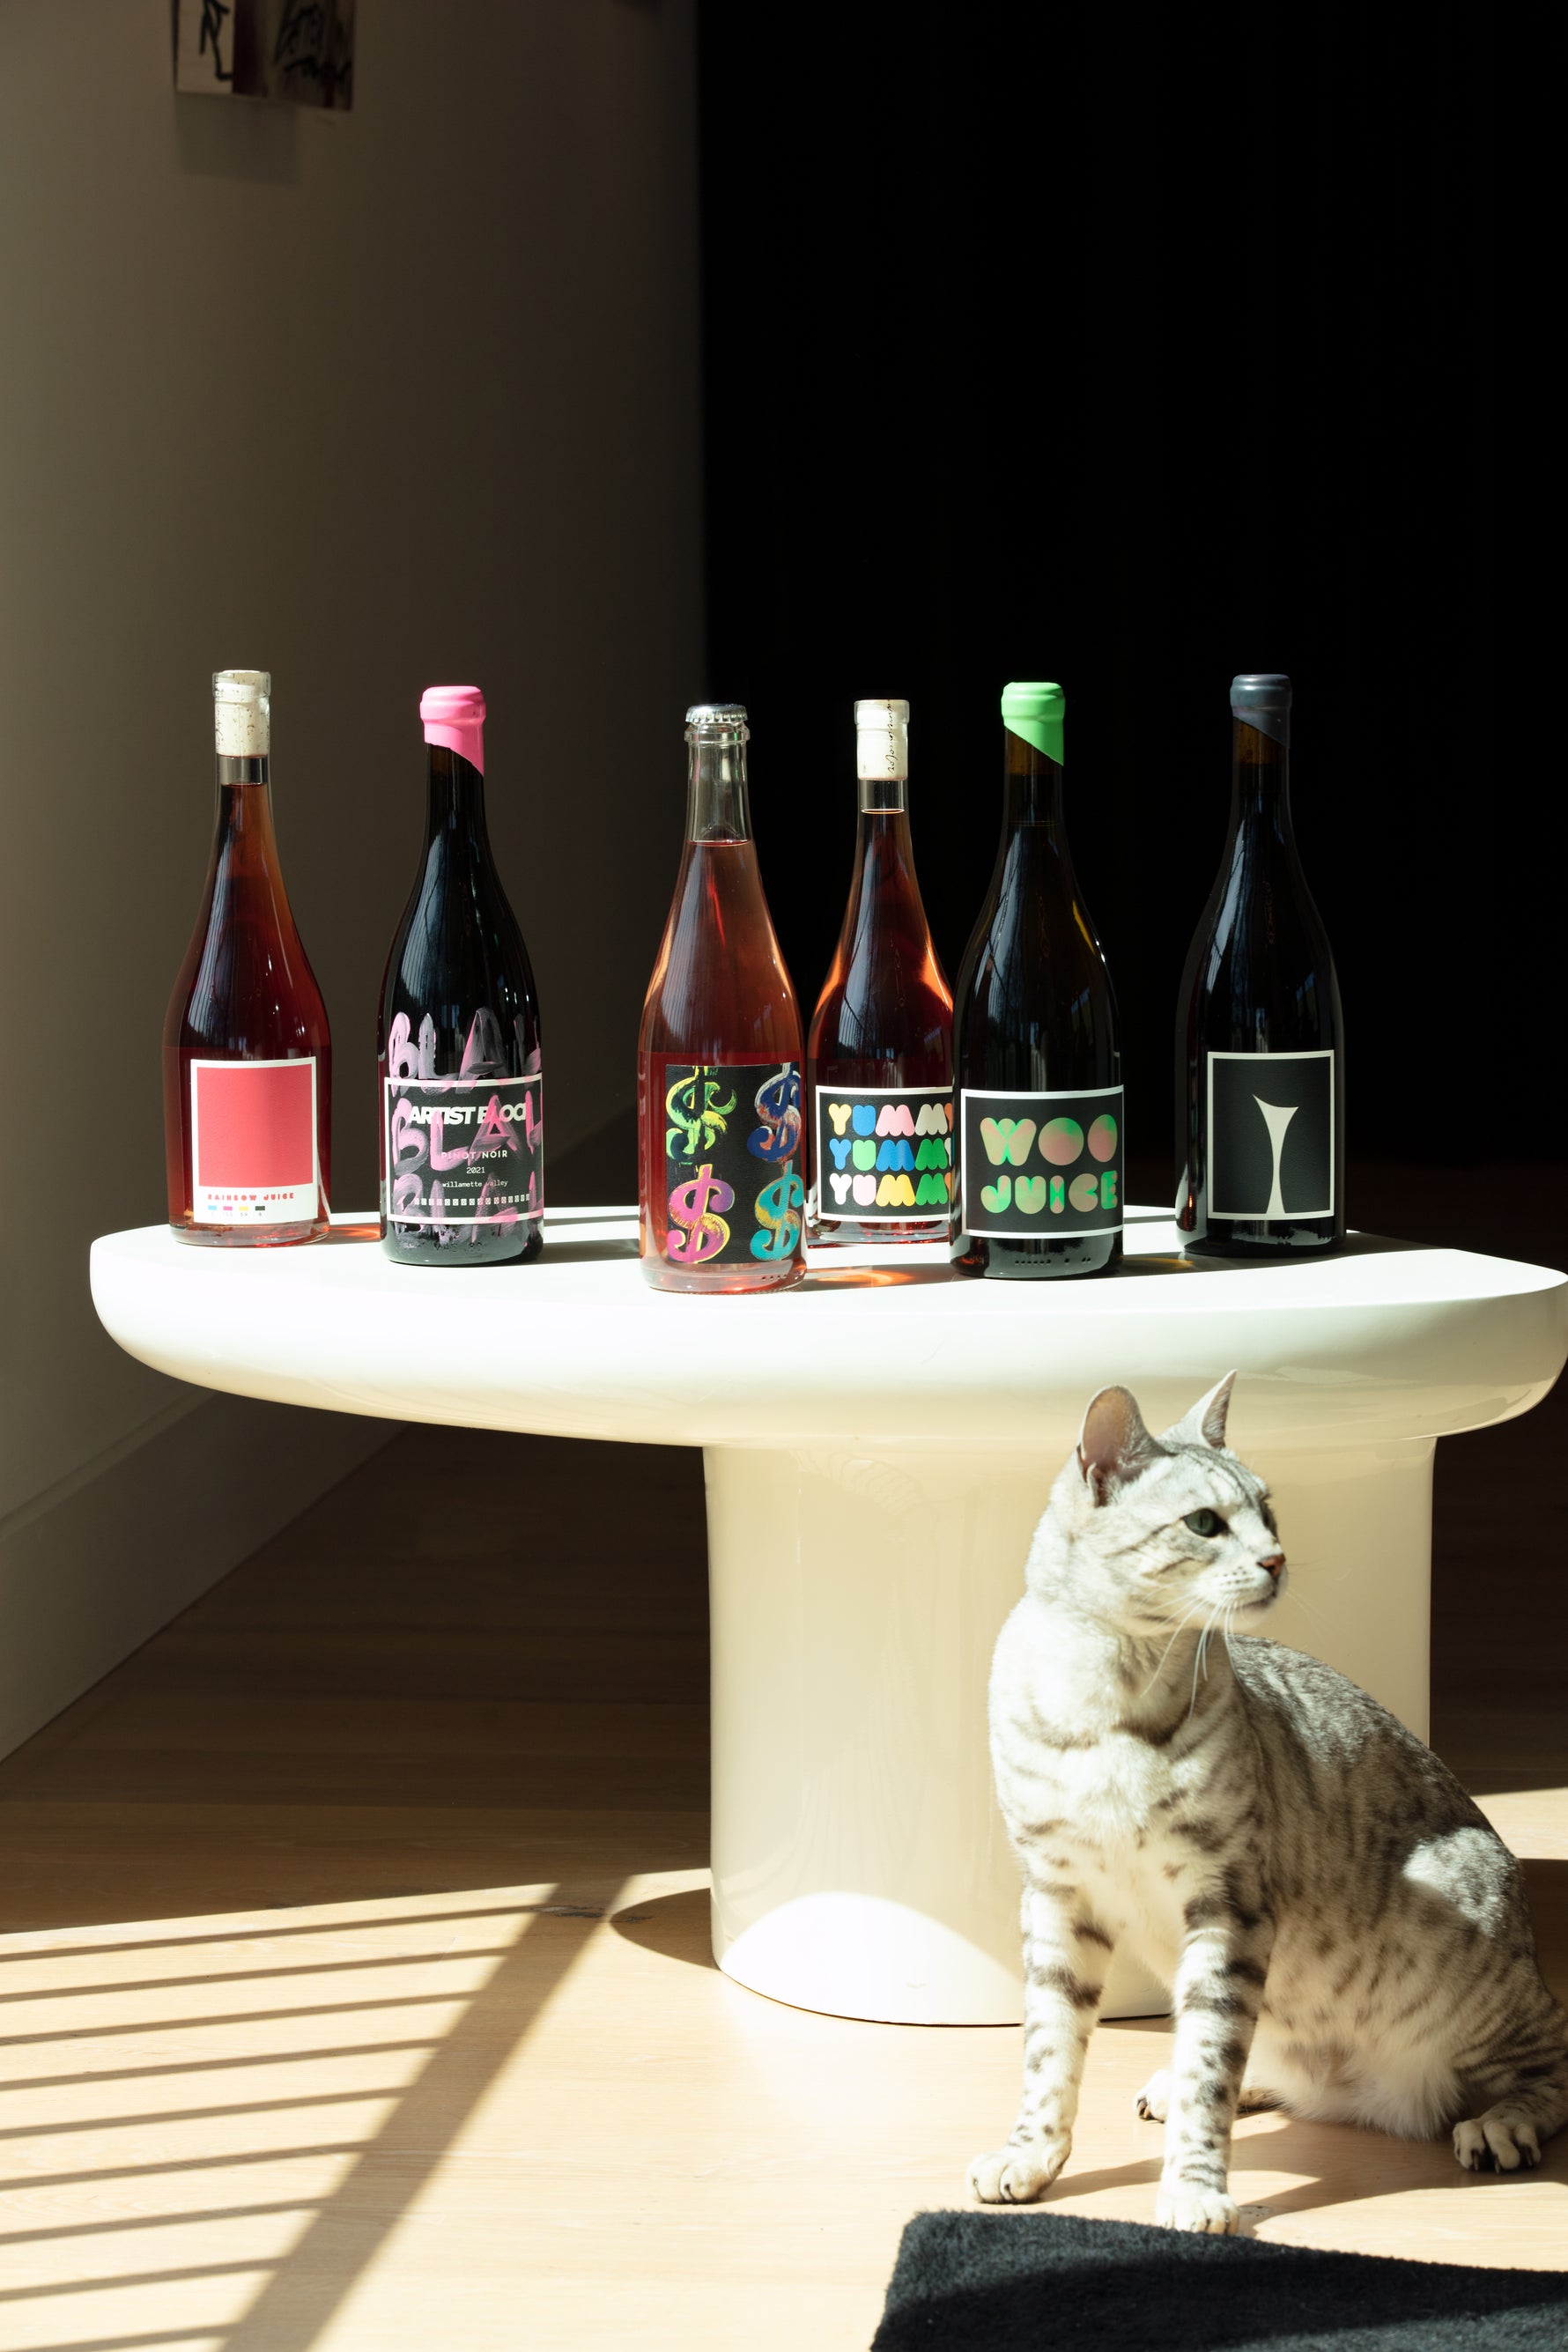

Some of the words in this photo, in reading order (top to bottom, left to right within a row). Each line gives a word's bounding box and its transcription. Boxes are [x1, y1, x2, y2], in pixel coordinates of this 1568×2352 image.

[409, 1106, 477, 1125] ARTIST
[980, 1113, 1118, 1166] WOO
[482, 1150, 508, 1159] NOIR
[263, 1192, 294, 1201] JUICE
[980, 1170, 1118, 1215] JUICE
